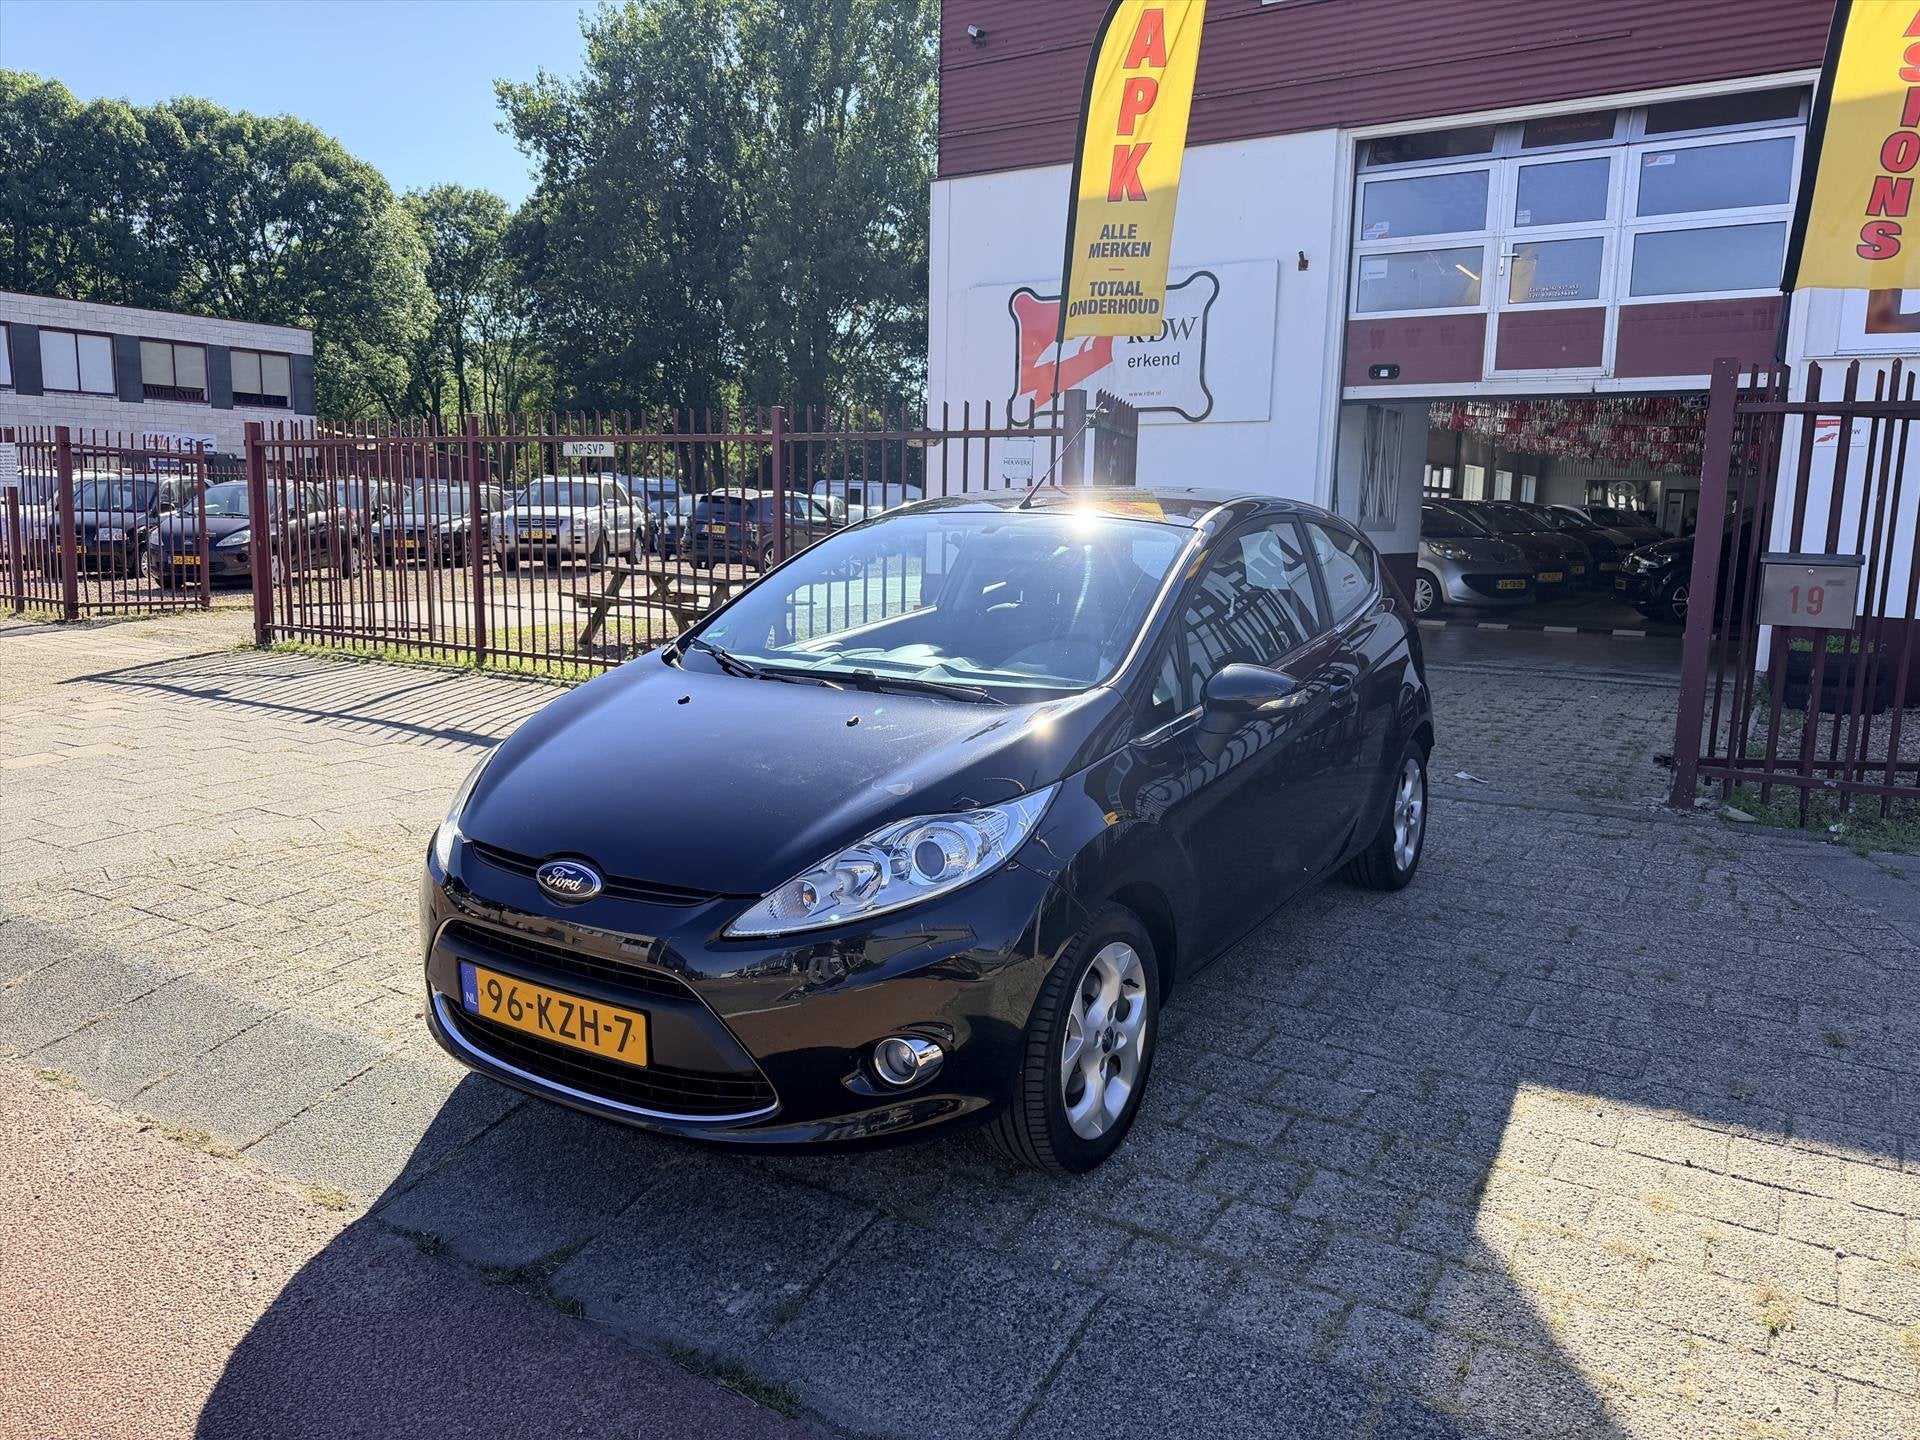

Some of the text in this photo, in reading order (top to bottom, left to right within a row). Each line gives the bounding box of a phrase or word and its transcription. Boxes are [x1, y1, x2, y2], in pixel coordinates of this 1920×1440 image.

[1107, 8, 1167, 202] APK
[1100, 223, 1138, 240] ALLE
[1088, 242, 1152, 259] MERKEN
[1089, 281, 1144, 297] TOTAAL
[1069, 298, 1160, 318] ONDERHOUD
[1127, 352, 1180, 368] erkend
[572, 443, 605, 457] NP-SVP
[1790, 585, 1825, 615] 19
[547, 866, 584, 892] Ford
[465, 978, 634, 1053] NL 96-KZH-7
